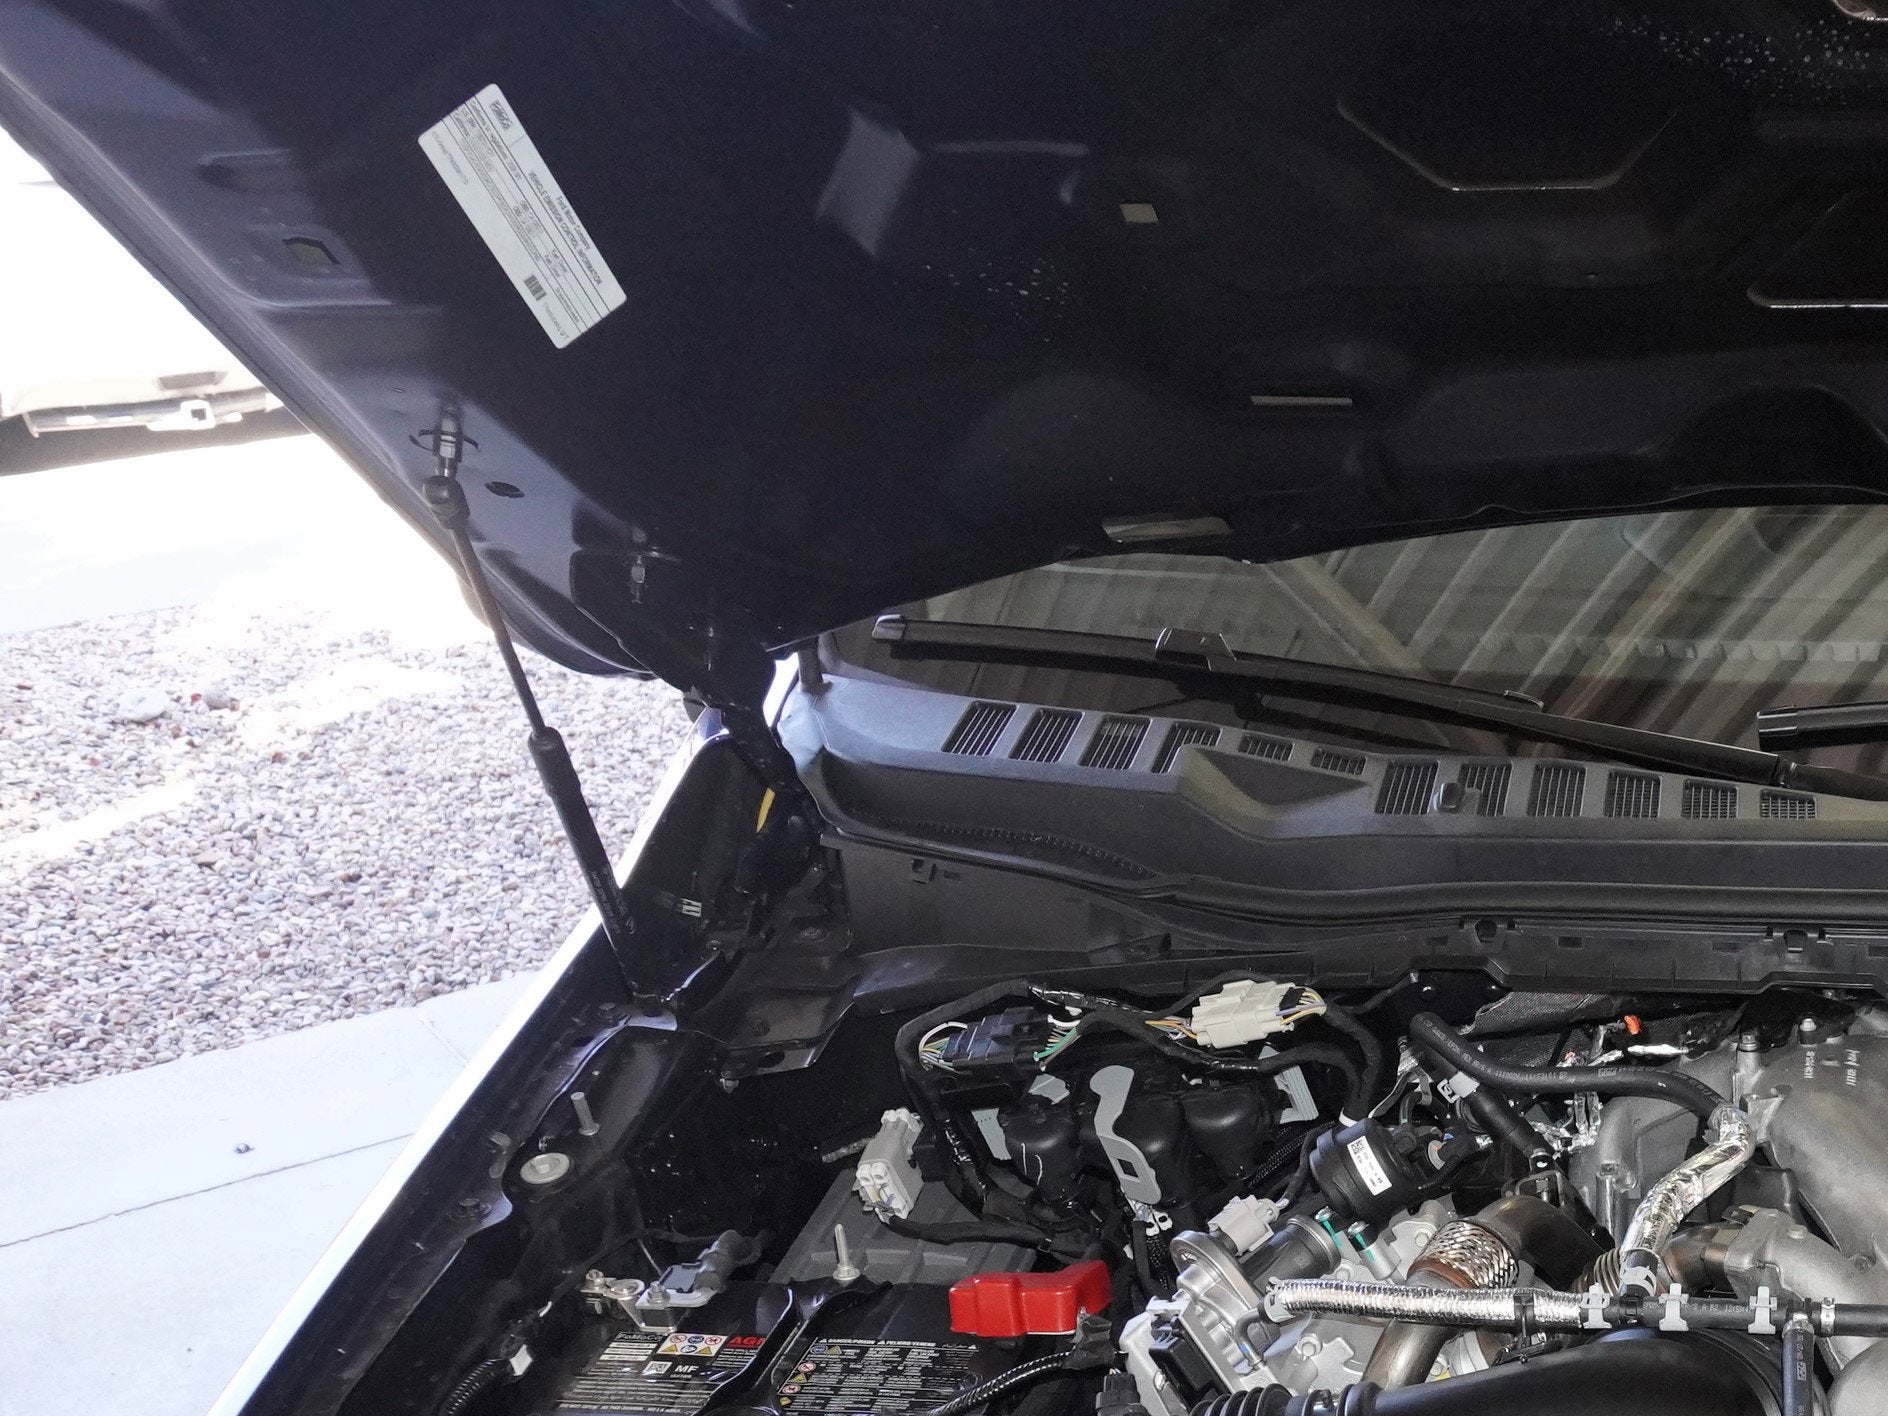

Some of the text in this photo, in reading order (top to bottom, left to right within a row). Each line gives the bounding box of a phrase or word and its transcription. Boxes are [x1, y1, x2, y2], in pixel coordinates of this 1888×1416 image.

[559, 221, 580, 249] CONTROL
[575, 247, 603, 286] INFORMATION
[616, 1333, 665, 1342] FoMoCo
[675, 1364, 699, 1373] MF
